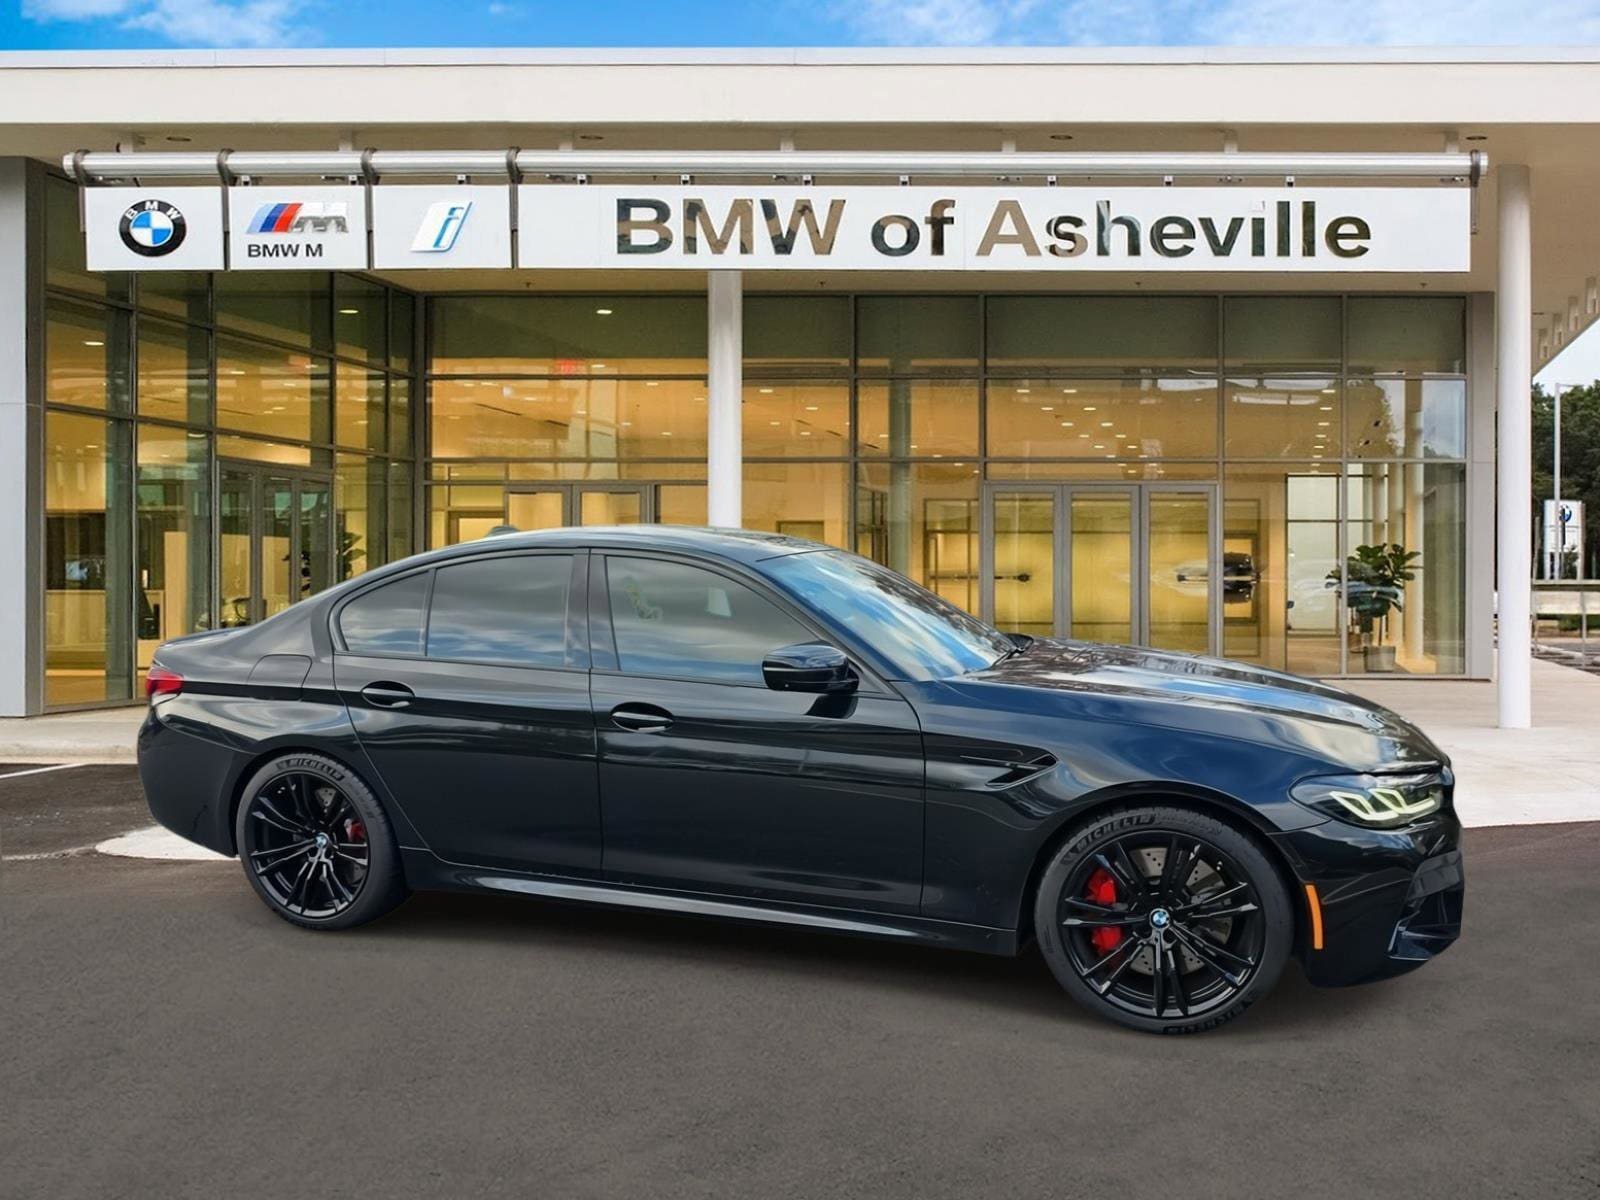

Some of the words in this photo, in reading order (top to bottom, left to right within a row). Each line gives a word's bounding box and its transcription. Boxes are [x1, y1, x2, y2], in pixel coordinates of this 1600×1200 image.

[125, 200, 181, 220] BMW
[616, 198, 846, 256] BMW
[871, 198, 956, 257] of
[975, 199, 1371, 258] Asheville
[247, 243, 300, 258] BMW
[305, 243, 323, 258] M
[288, 758, 344, 780] MICHELIN
[1075, 813, 1153, 852] MICHELIN
